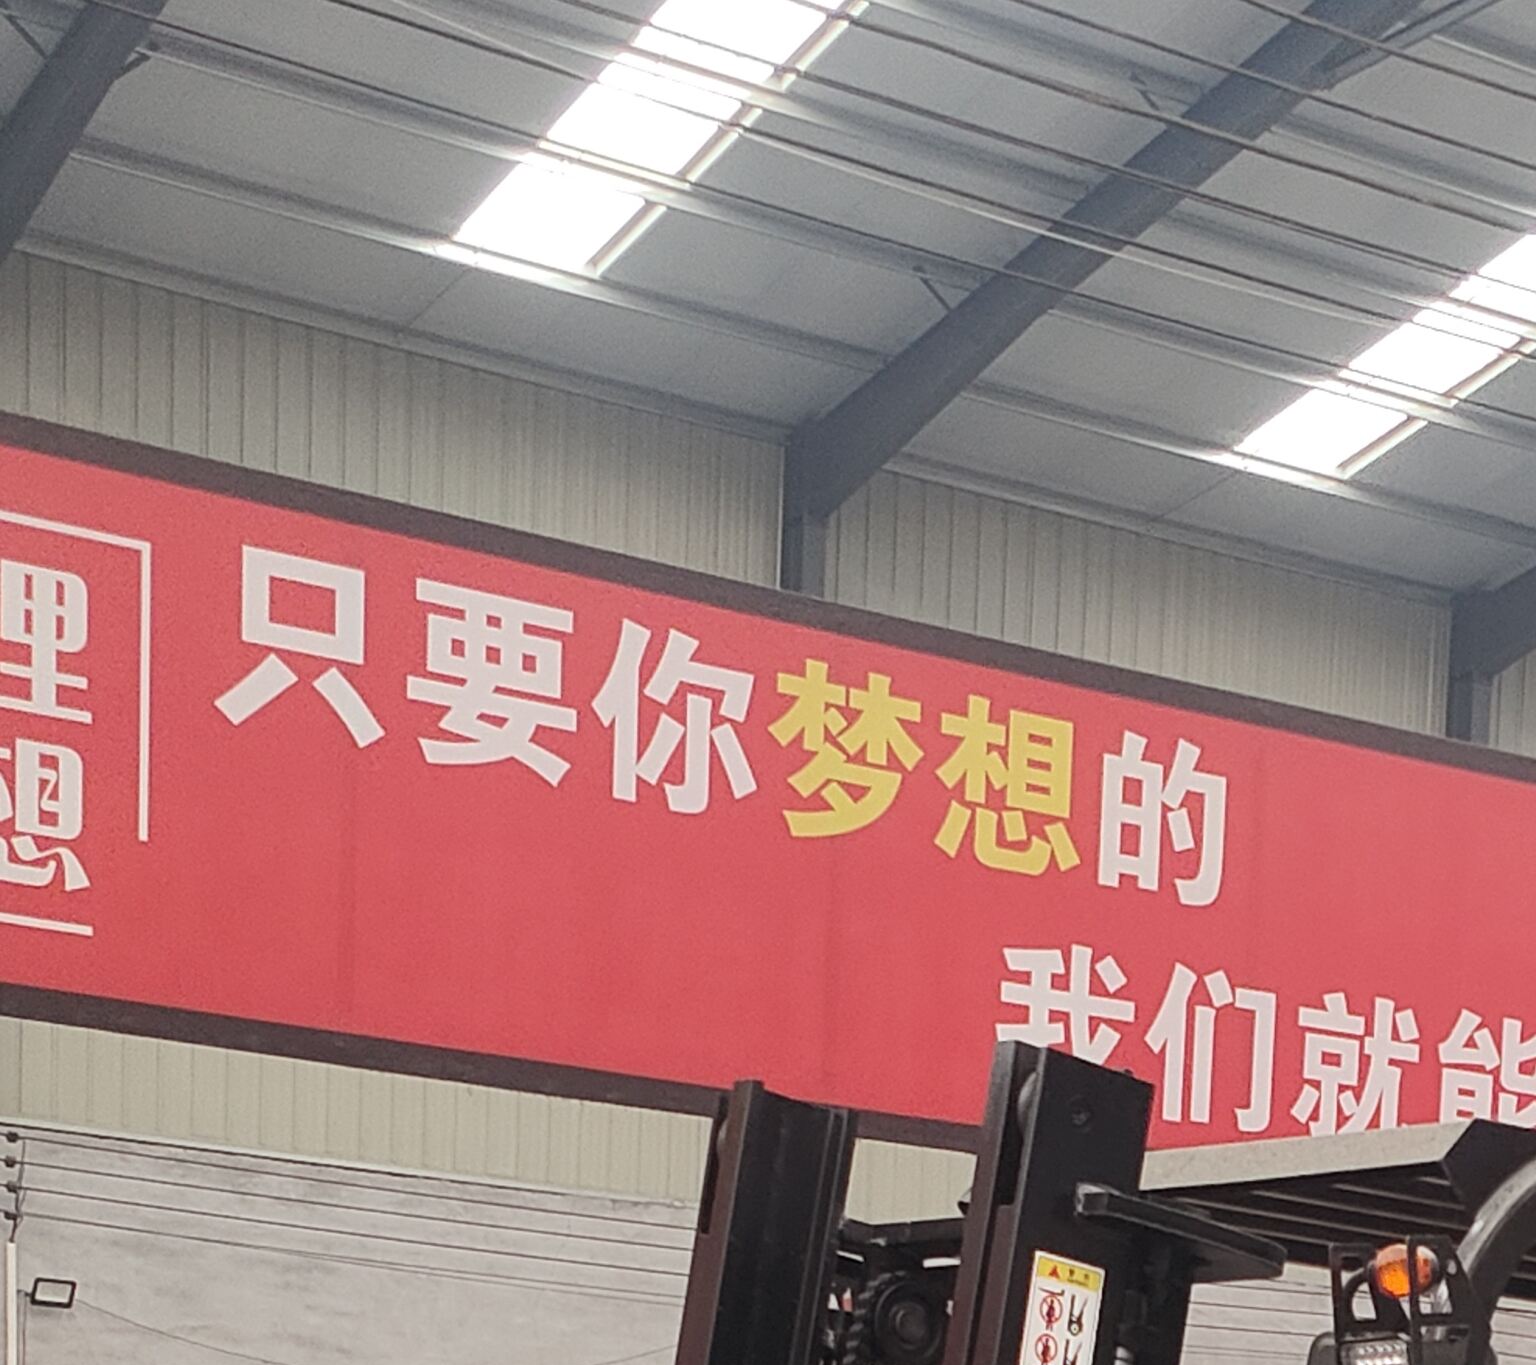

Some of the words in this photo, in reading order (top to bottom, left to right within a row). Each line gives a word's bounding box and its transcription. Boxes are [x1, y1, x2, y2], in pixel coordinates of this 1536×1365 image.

[214, 544, 1228, 907] 只要你梦想的
